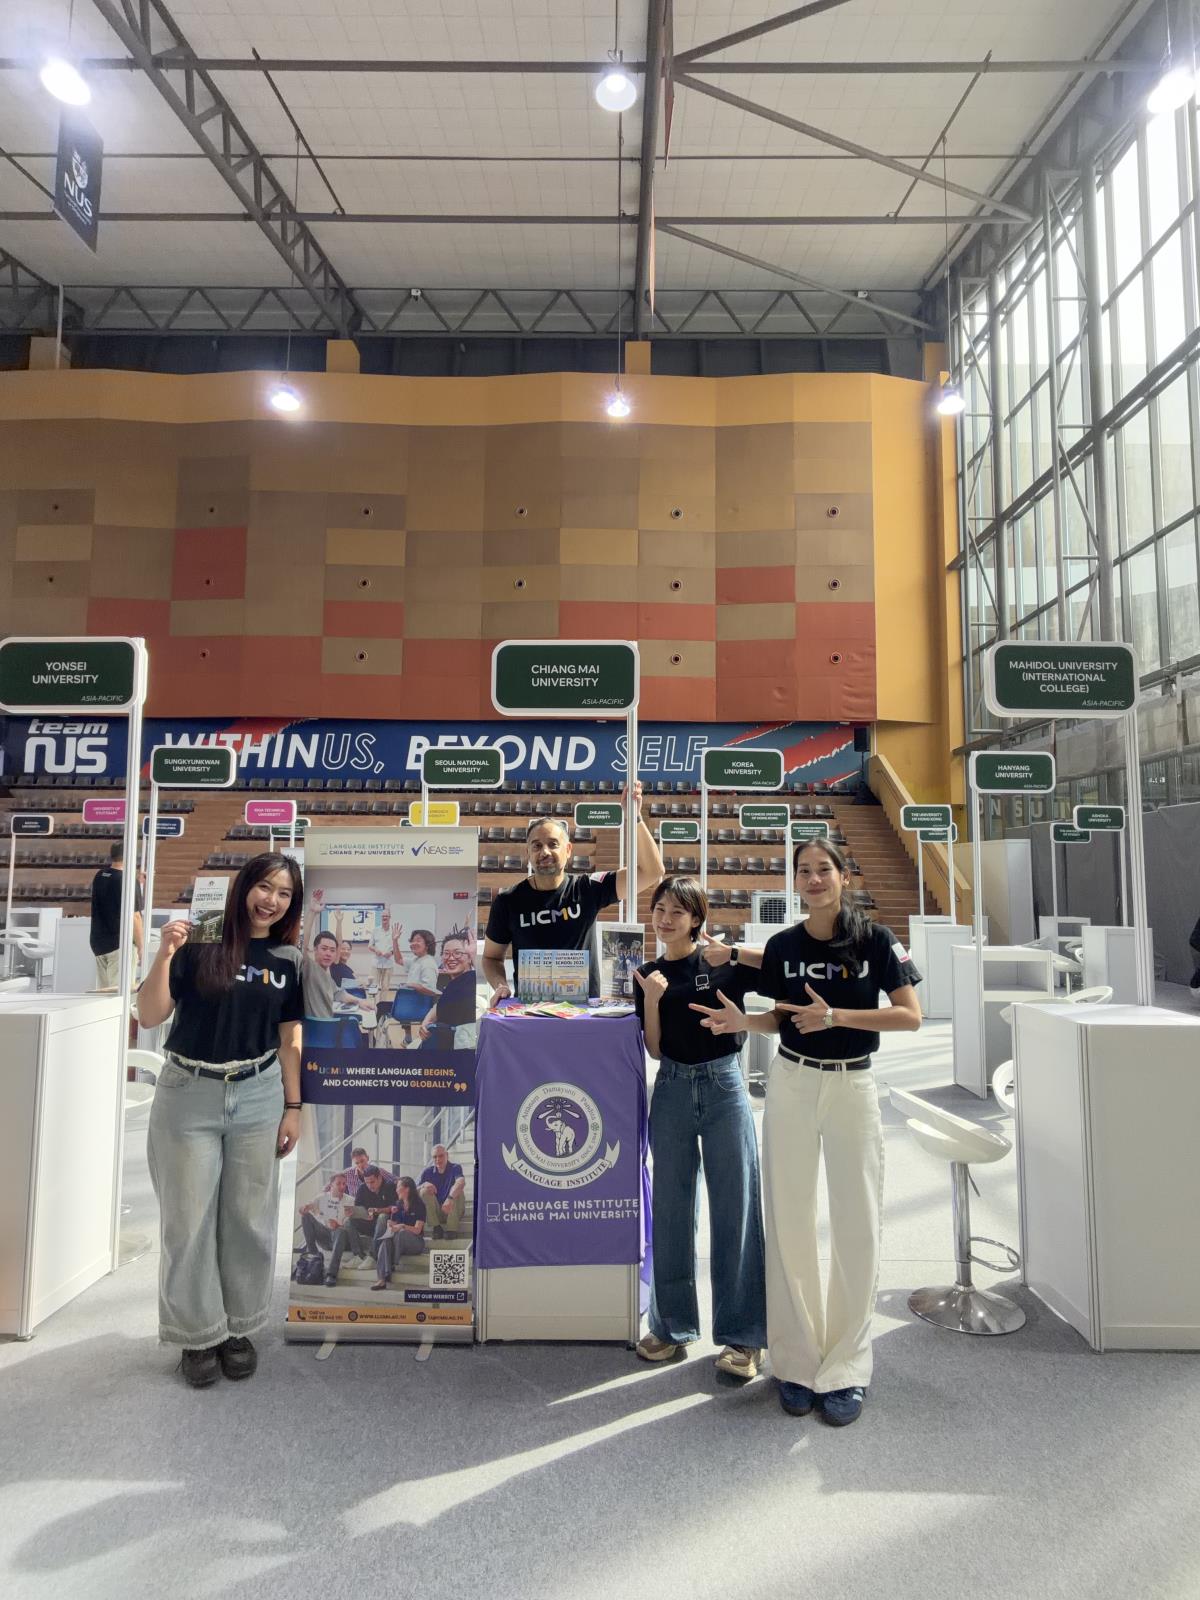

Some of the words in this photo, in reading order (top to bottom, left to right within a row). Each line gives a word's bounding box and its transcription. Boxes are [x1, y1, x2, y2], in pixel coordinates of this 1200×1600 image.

[64, 172, 92, 217] NUS
[46, 662, 86, 671] YONSEI
[531, 665, 576, 674] CHIANG
[578, 665, 599, 674] MAI
[1010, 661, 1056, 670] MAHIDOL
[1058, 662, 1118, 670] UNIVERSITY
[32, 675, 99, 684] UNIVERSITY
[1022, 672, 1106, 682] (INTERNATIONAL
[531, 678, 598, 687] UNIVERSITY
[1040, 684, 1089, 694] COLLEGE)
[28, 719, 108, 734] team
[611, 734, 708, 772] SELF
[520, 904, 580, 927] LICMU
[546, 1159, 579, 1168] UNIVERSITY
[518, 1163, 562, 1187] LANGUAGE
[567, 1162, 608, 1186] INSTITUTE
[502, 1201, 569, 1211] LANGUAGE
[574, 1199, 639, 1209] INSTITUTE
[503, 1212, 544, 1222] CHIANG
[550, 1212, 569, 1220] MAI
[574, 1210, 639, 1220] UNIVERSITY
